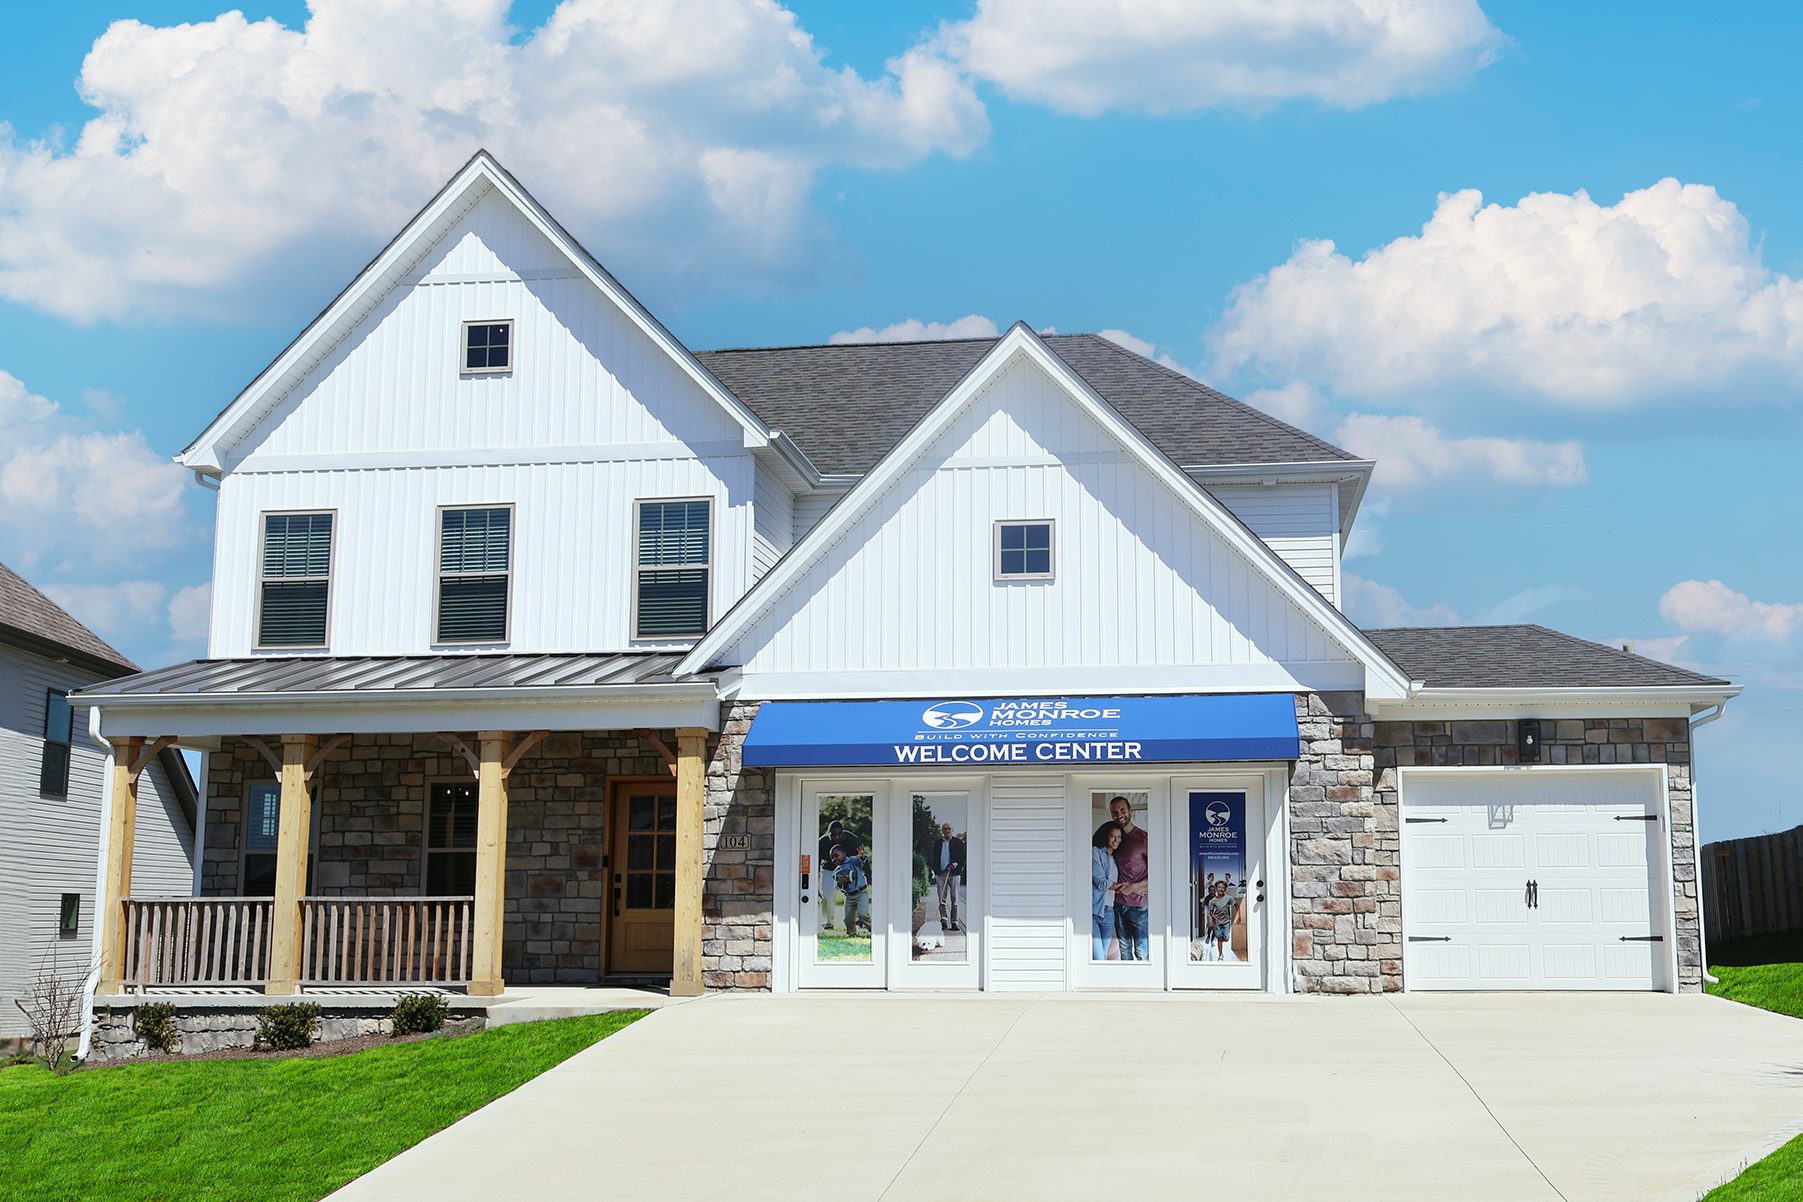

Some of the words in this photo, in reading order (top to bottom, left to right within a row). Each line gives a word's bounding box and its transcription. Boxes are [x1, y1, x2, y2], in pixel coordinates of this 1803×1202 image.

[993, 701, 1068, 710] JAMES
[990, 708, 1121, 720] MONROE
[988, 719, 1052, 727] HOMES
[894, 743, 1028, 763] WELCOME
[1035, 741, 1142, 760] CENTER
[724, 836, 745, 848] 104
